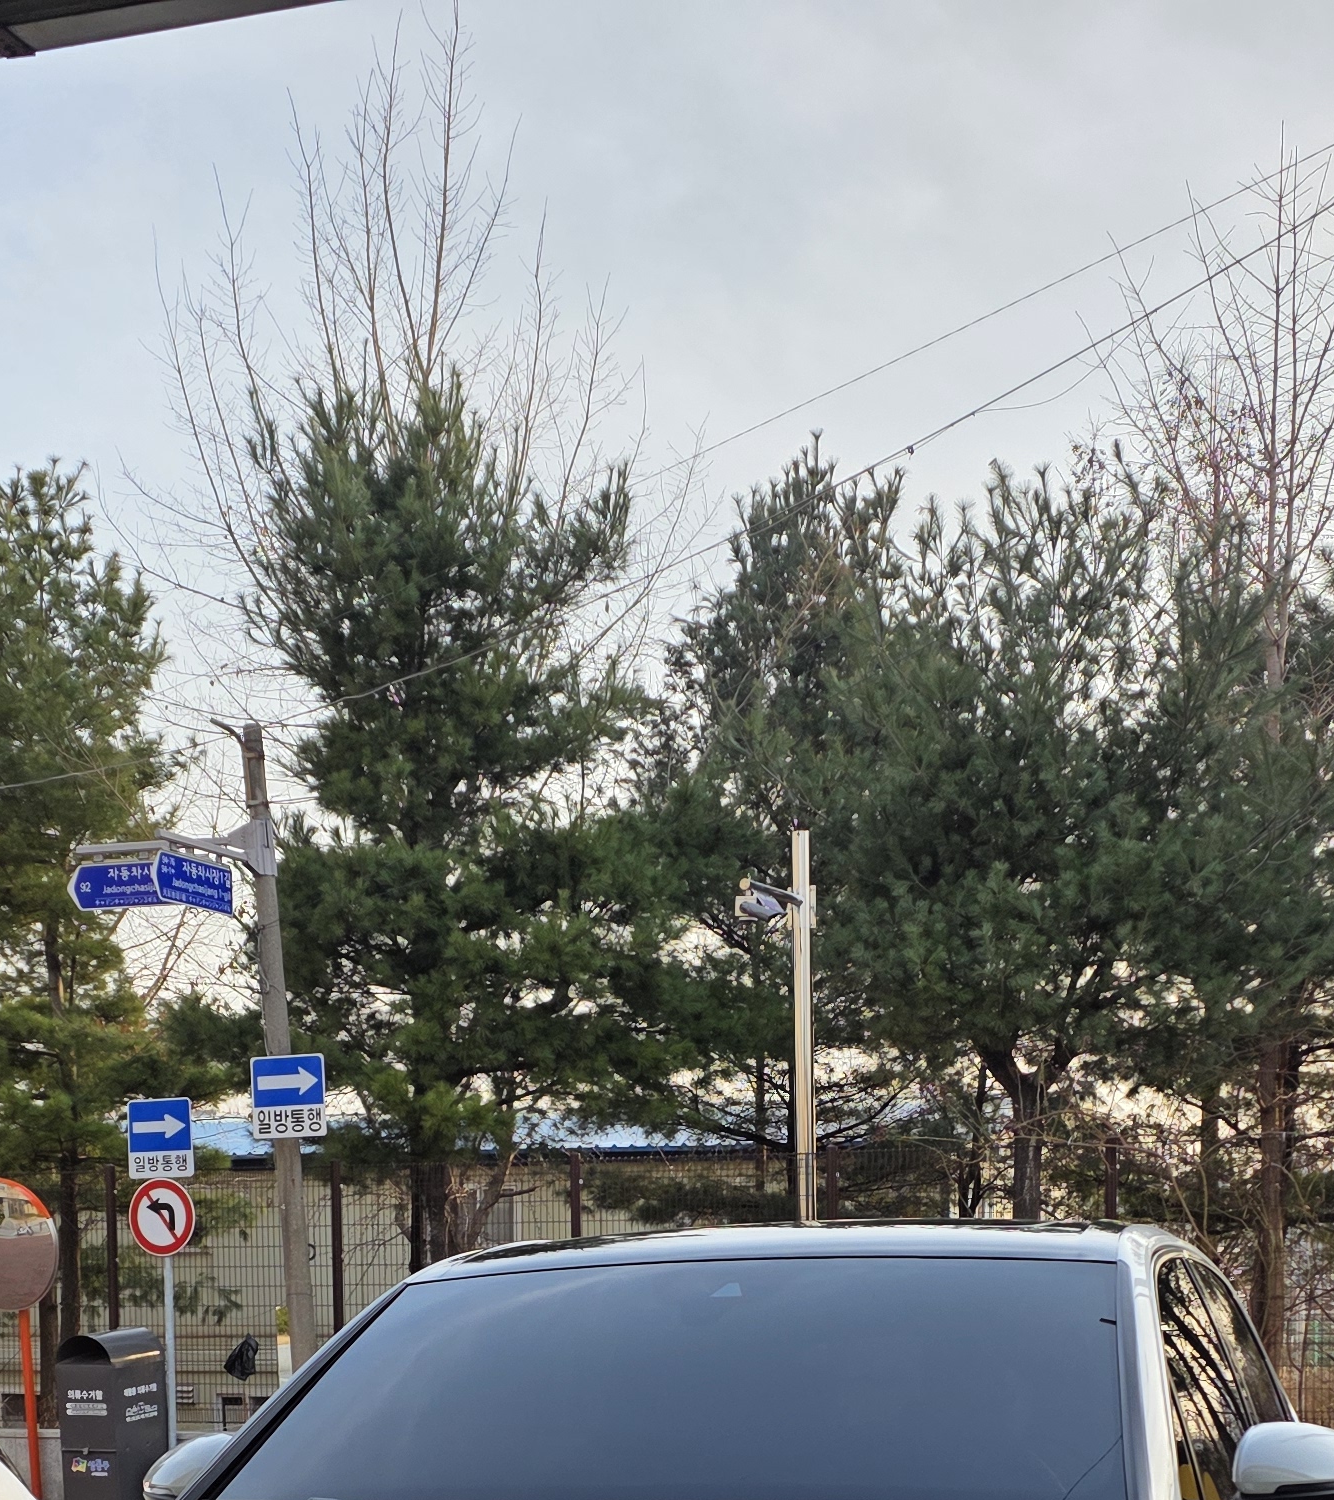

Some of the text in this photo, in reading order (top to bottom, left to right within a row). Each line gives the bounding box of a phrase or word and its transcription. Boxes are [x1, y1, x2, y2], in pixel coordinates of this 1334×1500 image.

[182, 862, 231, 888] 자동차시장1길
[80, 882, 91, 892] 92
[257, 1107, 322, 1135] 일방통행
[134, 1154, 188, 1173] 일방통행
[67, 1389, 104, 1400] 의류수거함
